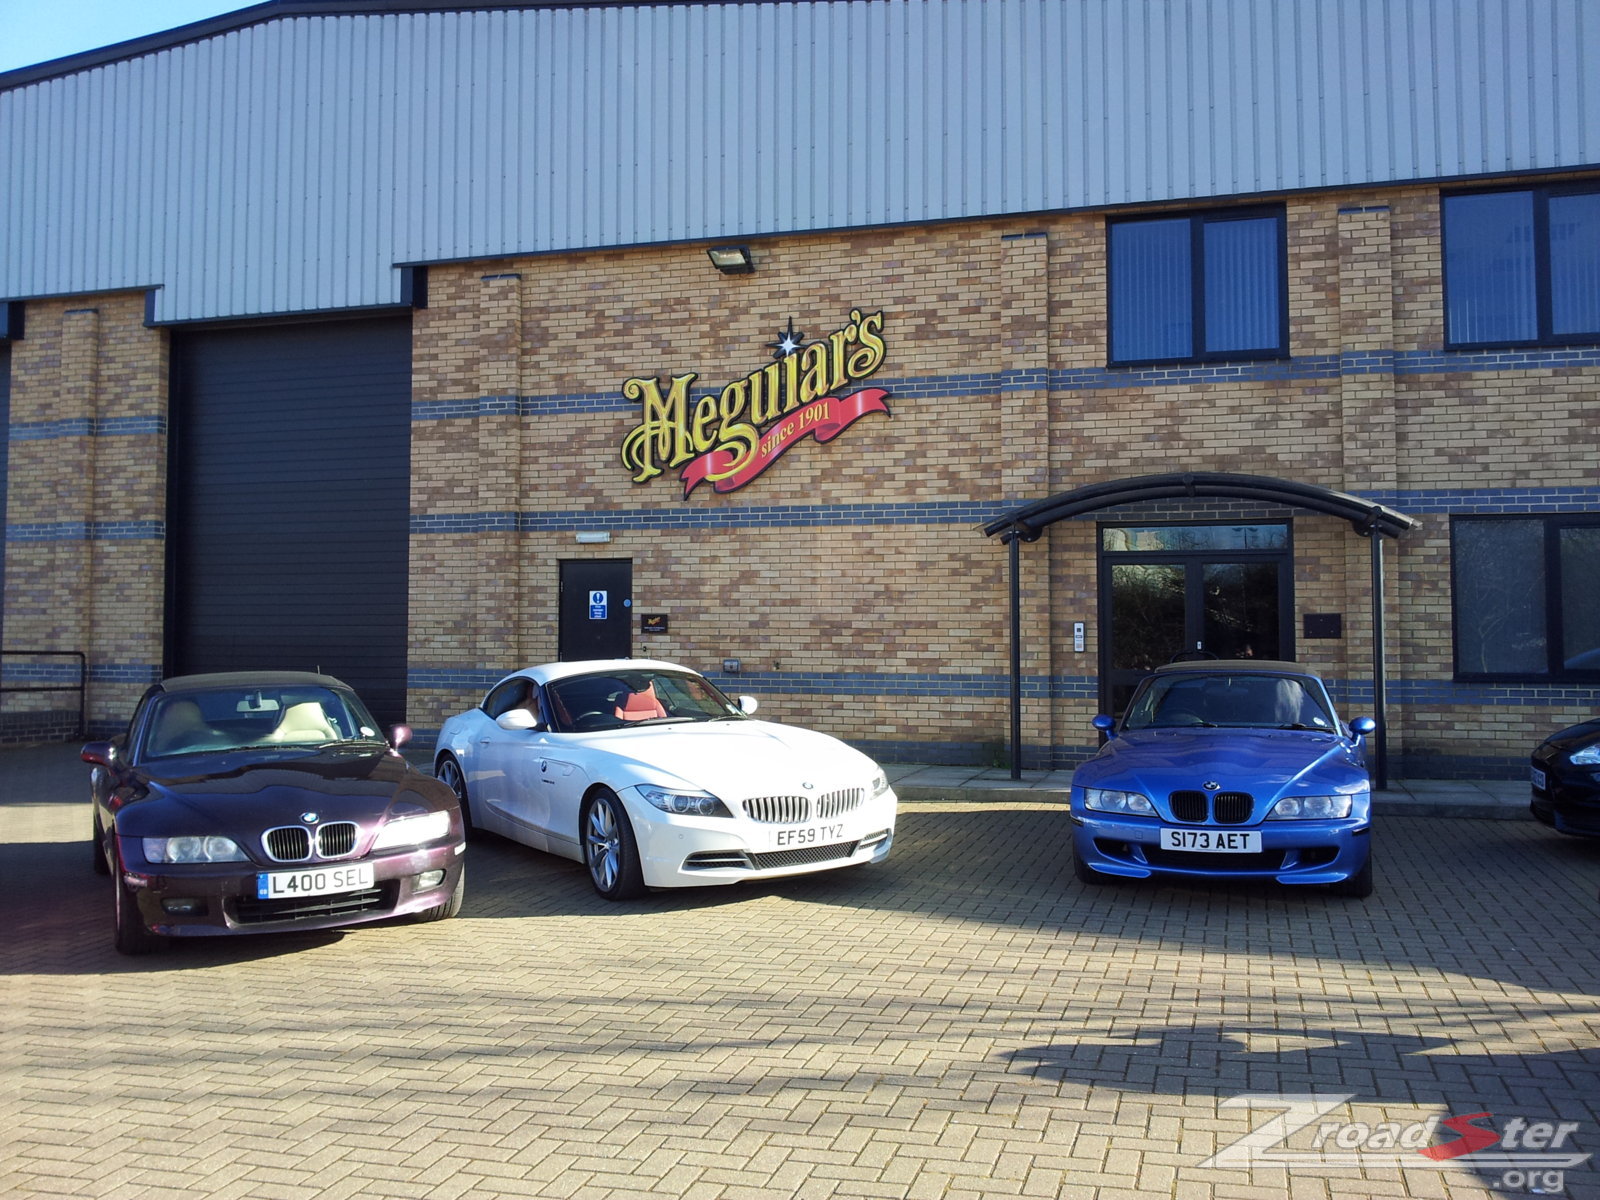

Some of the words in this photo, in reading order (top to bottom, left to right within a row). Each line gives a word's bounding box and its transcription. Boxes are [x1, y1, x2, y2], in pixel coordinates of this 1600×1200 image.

[622, 309, 885, 483] Meguiar's
[761, 422, 795, 458] since
[799, 401, 830, 430] 1901
[777, 828, 815, 846] EF59
[820, 824, 844, 841] TYZ
[1171, 831, 1210, 849] S173
[1216, 833, 1250, 850] AET
[272, 873, 326, 894] L400
[333, 868, 368, 888] SEL
